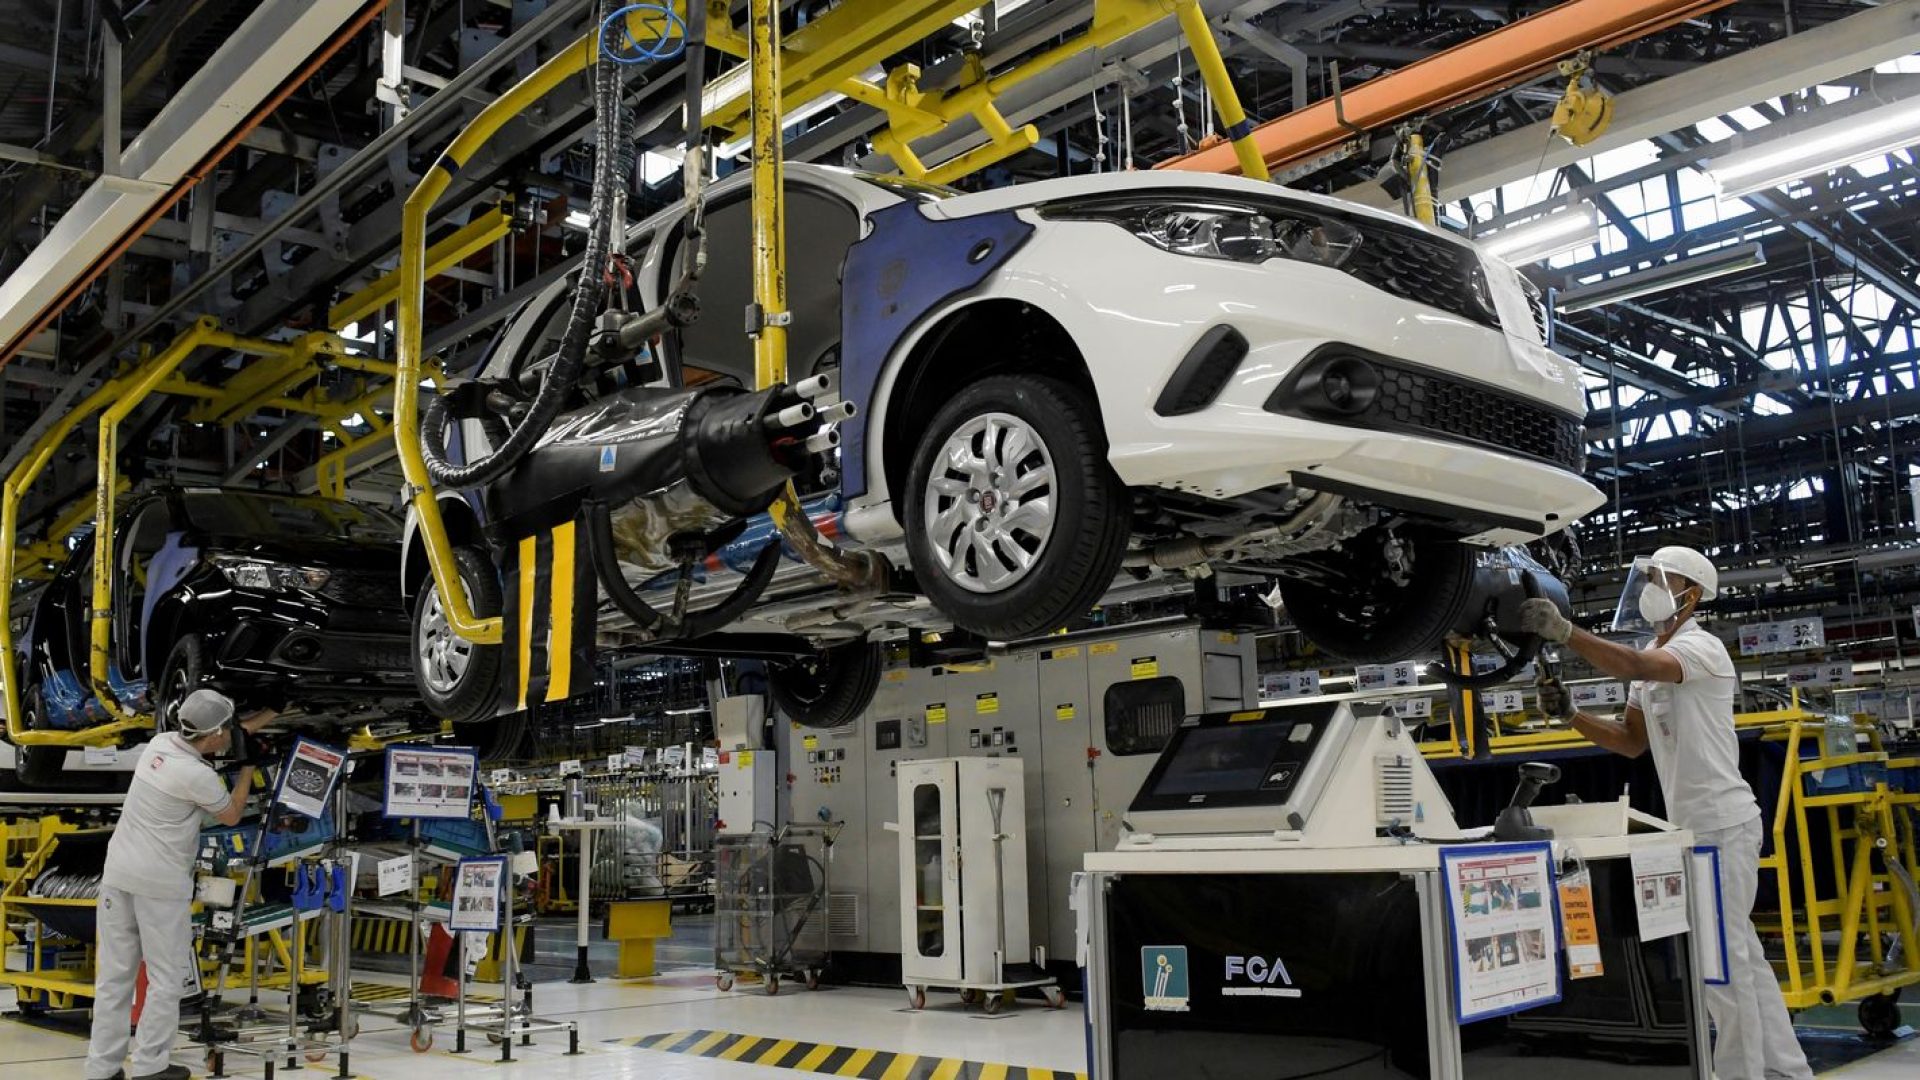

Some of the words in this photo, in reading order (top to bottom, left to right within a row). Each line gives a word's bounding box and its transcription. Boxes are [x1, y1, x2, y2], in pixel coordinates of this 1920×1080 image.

[1394, 667, 1408, 678] 36
[1830, 667, 1842, 676] 48
[1299, 677, 1311, 687] 24
[1605, 687, 1617, 696] 56
[1503, 695, 1514, 704] 22
[1225, 955, 1292, 985] FCA
